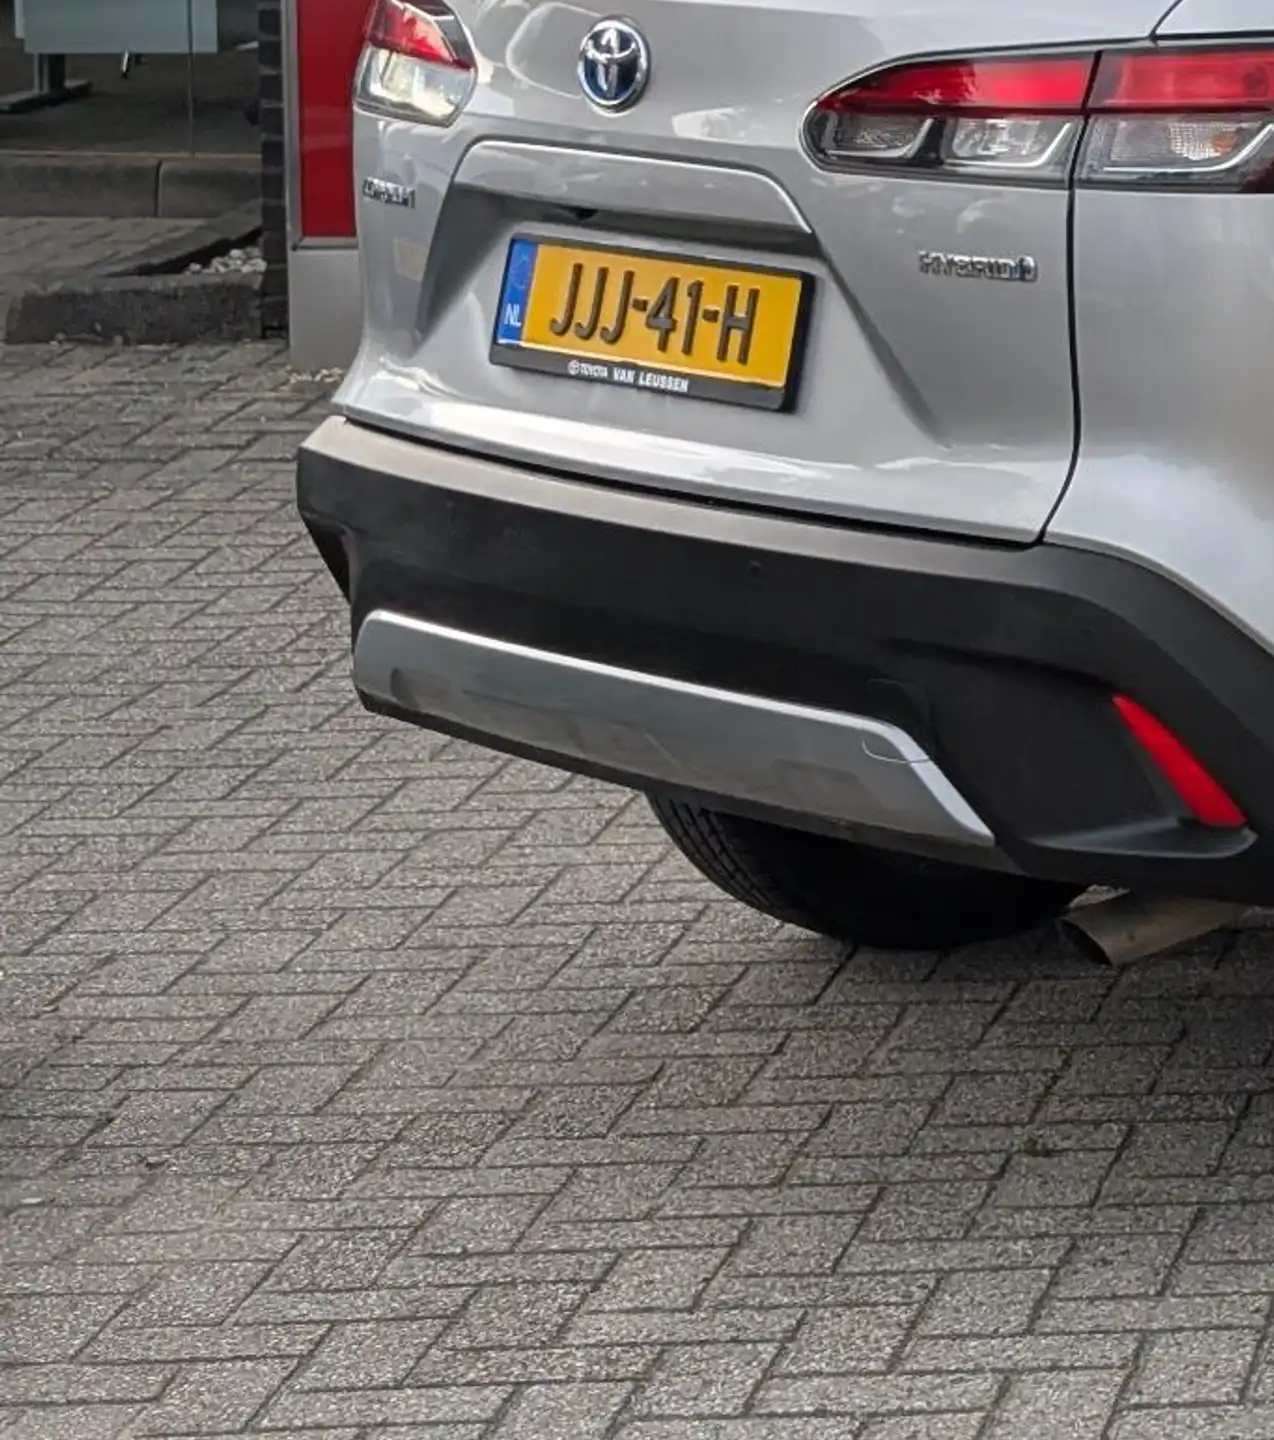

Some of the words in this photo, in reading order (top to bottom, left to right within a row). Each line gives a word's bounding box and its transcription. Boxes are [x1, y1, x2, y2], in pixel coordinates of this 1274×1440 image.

[504, 302, 522, 327] NL
[550, 262, 759, 365] JJJ-41-H
[580, 362, 608, 378] TOYOTA
[613, 367, 636, 384] VAN
[638, 371, 689, 393] LEUSSEN
